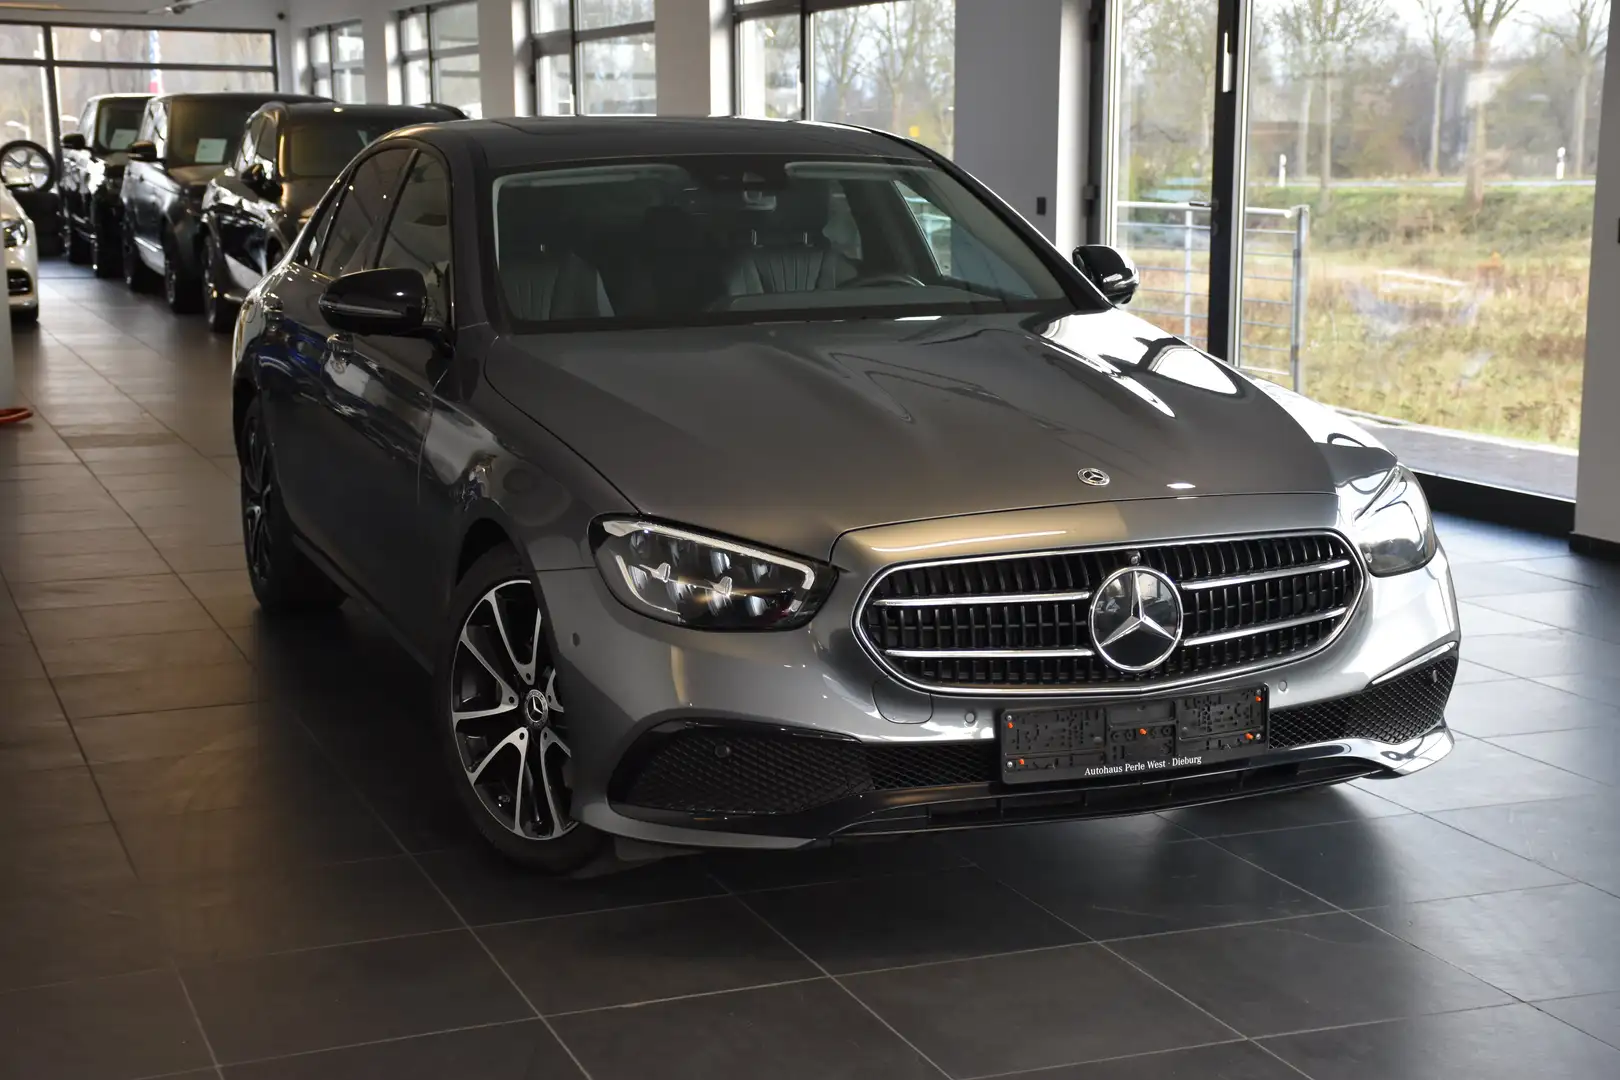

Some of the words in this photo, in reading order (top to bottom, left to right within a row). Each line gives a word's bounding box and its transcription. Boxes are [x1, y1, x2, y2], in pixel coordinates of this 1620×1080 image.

[1084, 765, 1123, 776] Autohaus
[1124, 763, 1145, 772] Perle
[1147, 760, 1166, 769] West
[1172, 756, 1202, 767] Dieburg
